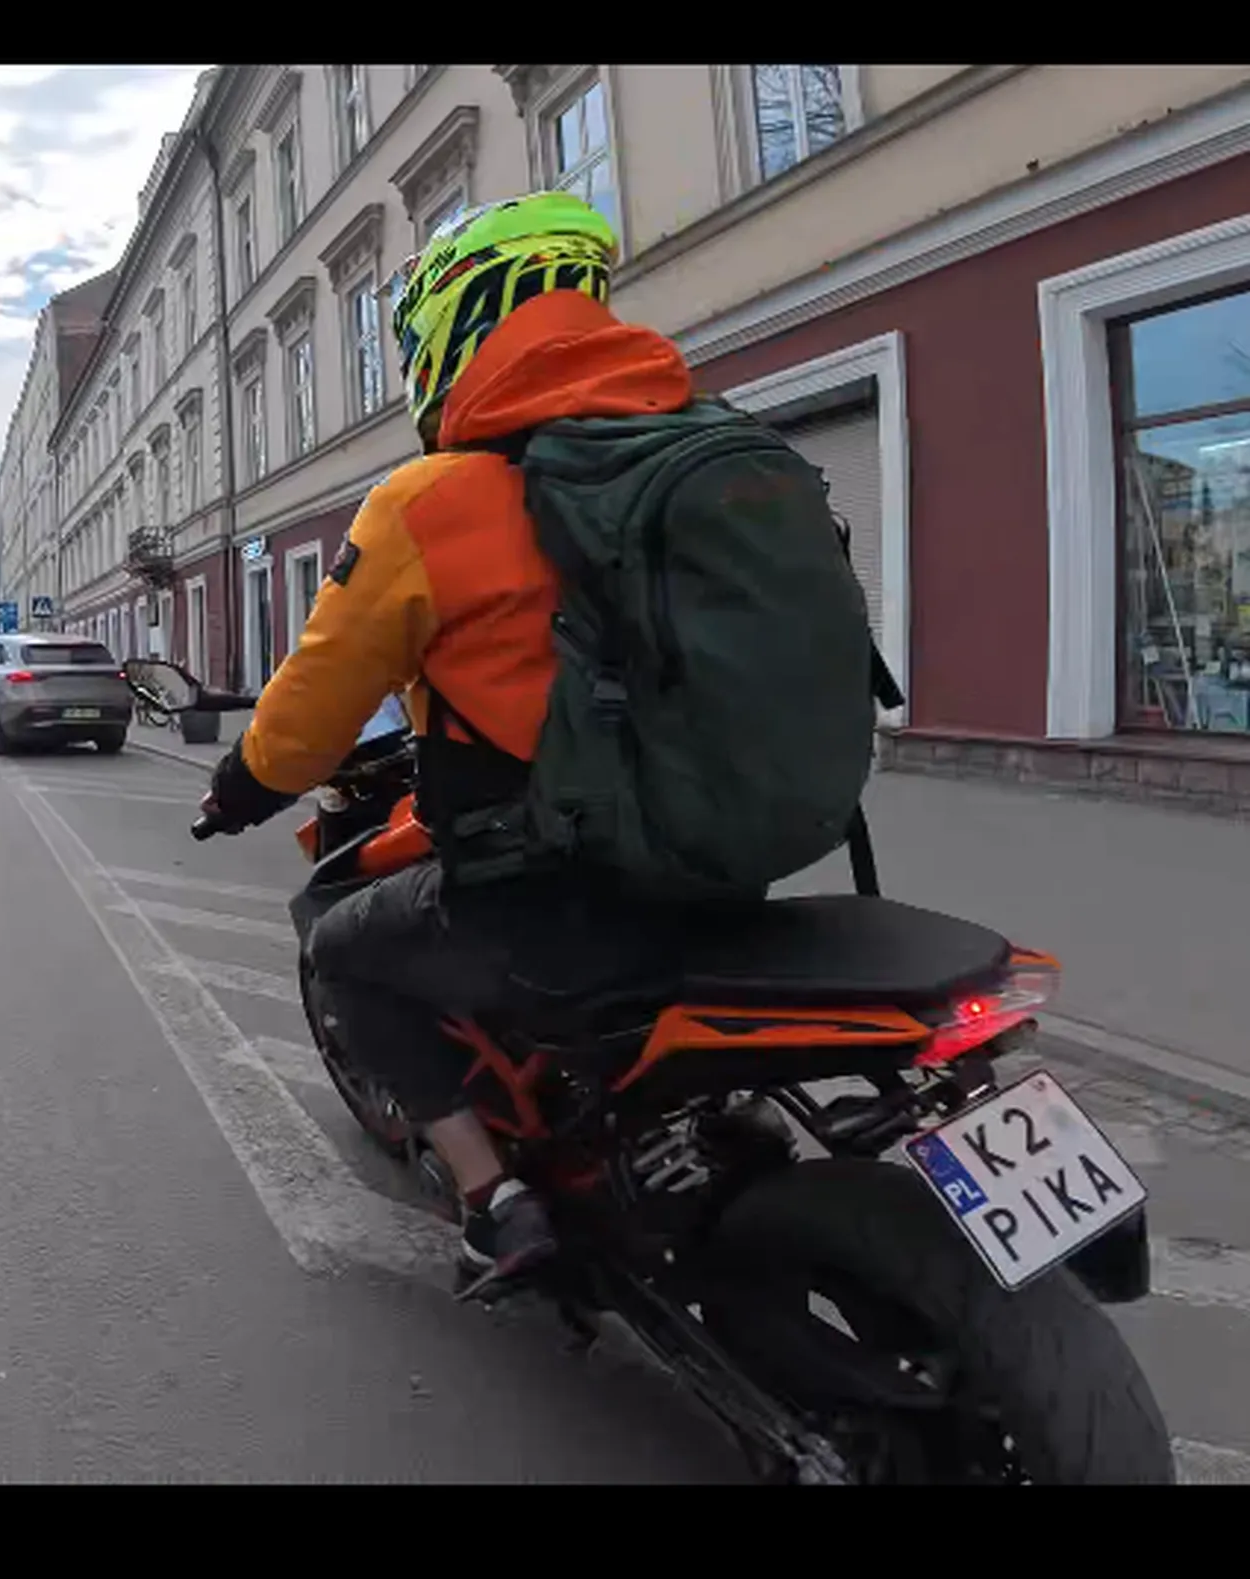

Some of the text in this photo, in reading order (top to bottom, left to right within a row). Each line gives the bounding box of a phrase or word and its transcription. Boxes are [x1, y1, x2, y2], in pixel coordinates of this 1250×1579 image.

[962, 1107, 1052, 1178] K2
[943, 1178, 983, 1208] PL
[982, 1153, 1124, 1262] PIKA
